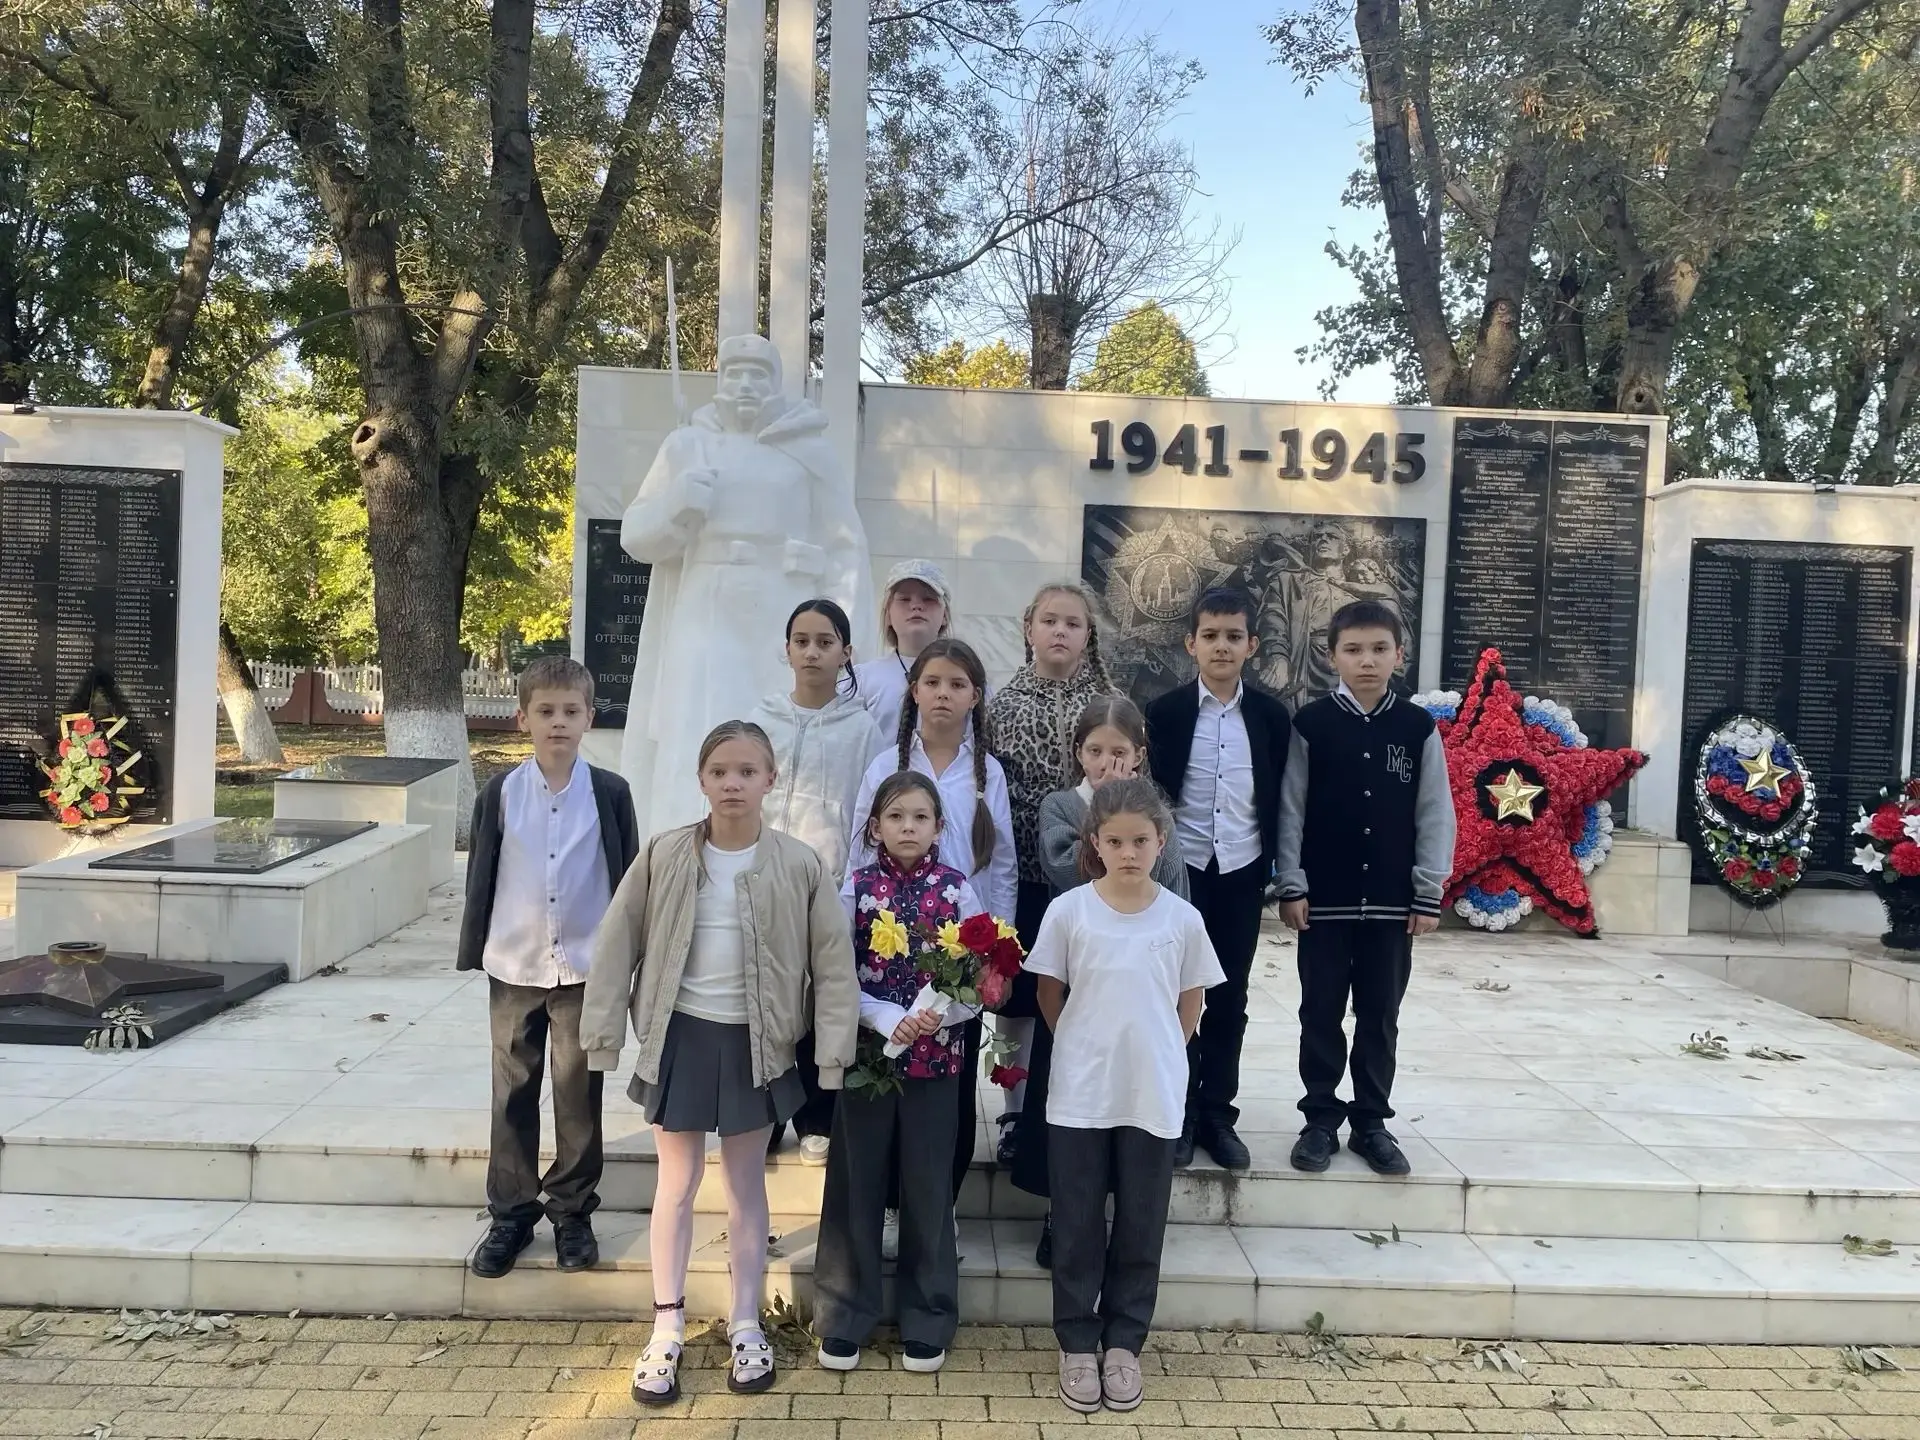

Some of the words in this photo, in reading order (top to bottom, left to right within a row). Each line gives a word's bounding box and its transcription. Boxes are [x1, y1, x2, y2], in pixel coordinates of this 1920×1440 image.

[1090, 419, 1426, 483] 1941-1945
[612, 574, 649, 585] ПОГИБ
[623, 594, 630, 604] В
[595, 632, 639, 645] ОТЕЧЕС
